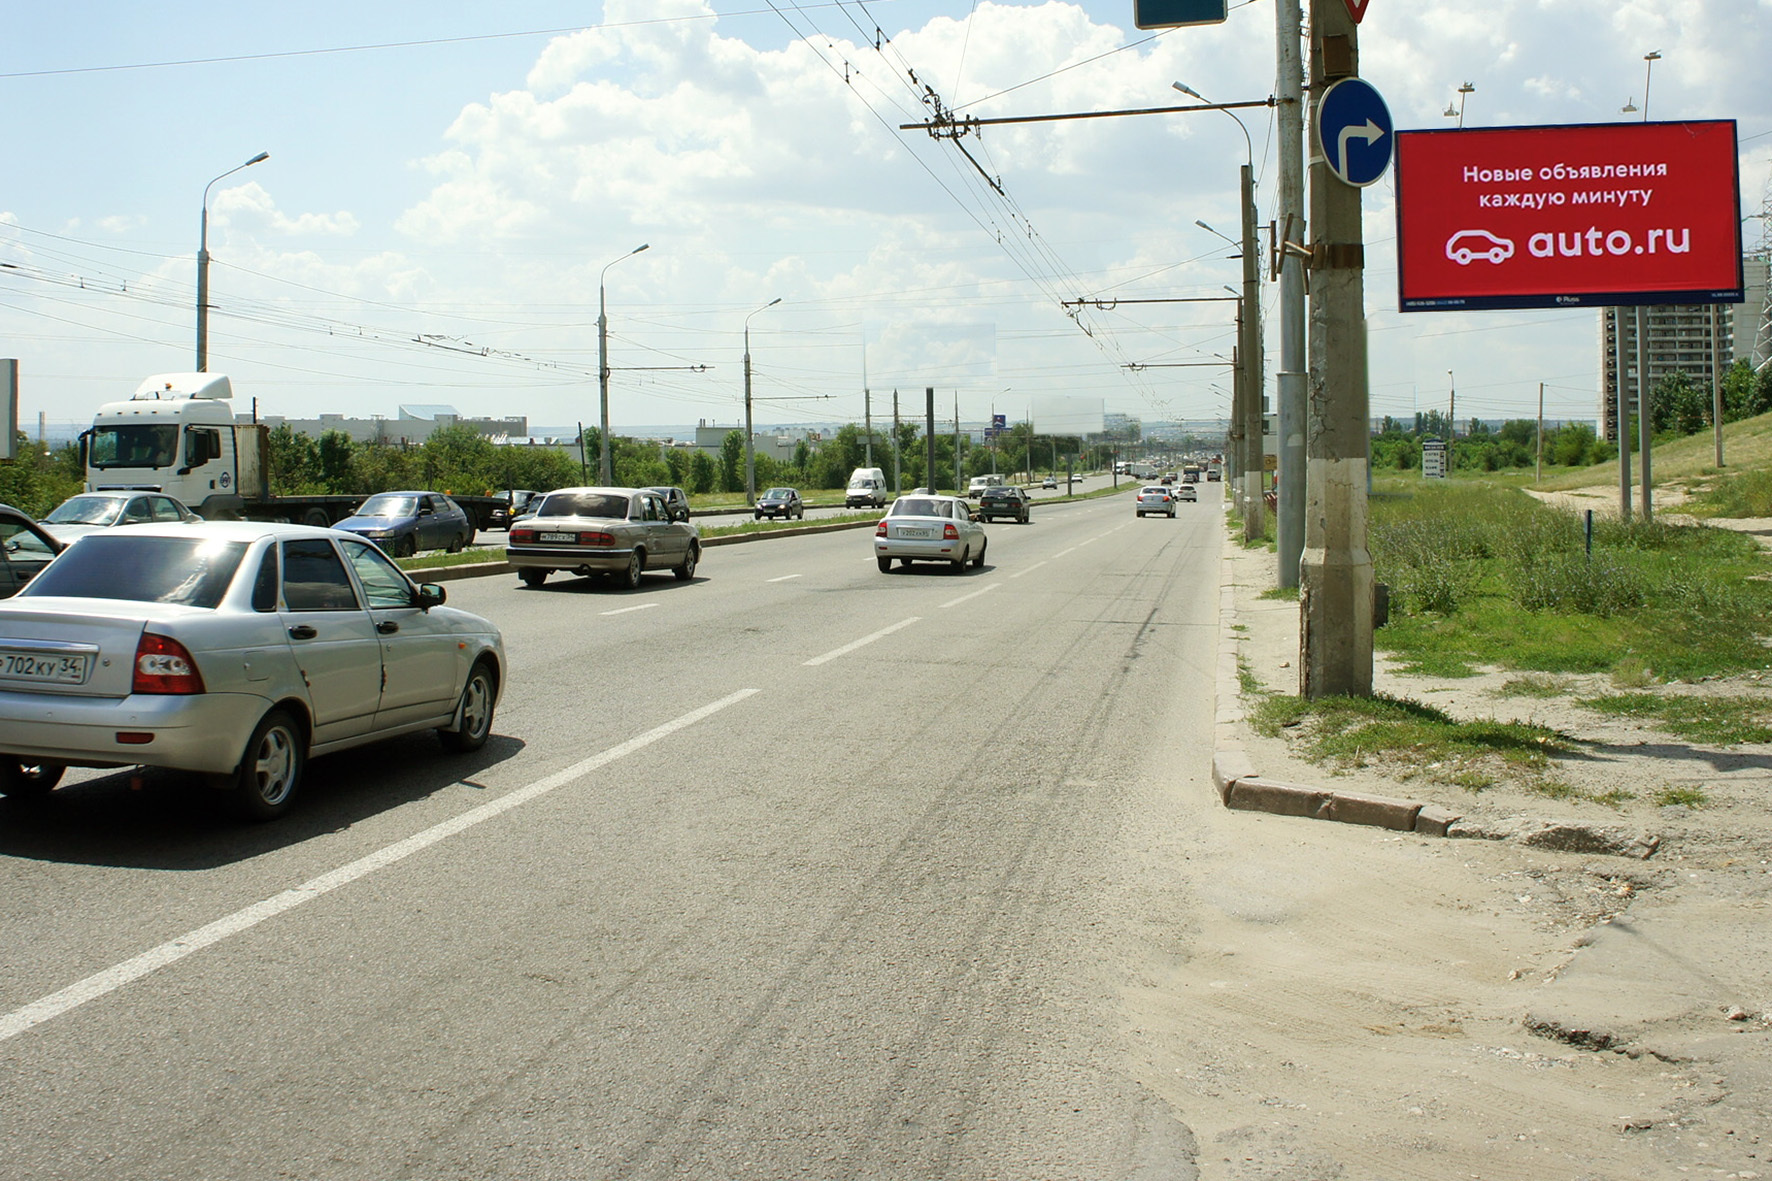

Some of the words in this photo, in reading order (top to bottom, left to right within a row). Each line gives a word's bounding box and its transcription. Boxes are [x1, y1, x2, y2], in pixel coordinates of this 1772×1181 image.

[1463, 165, 1533, 183] Новые
[1539, 163, 1668, 180] объявления
[1479, 191, 1566, 209] каждую
[1571, 189, 1653, 207] минуту
[1528, 226, 1690, 258] auto.ru
[60, 658, 77, 673] 34
